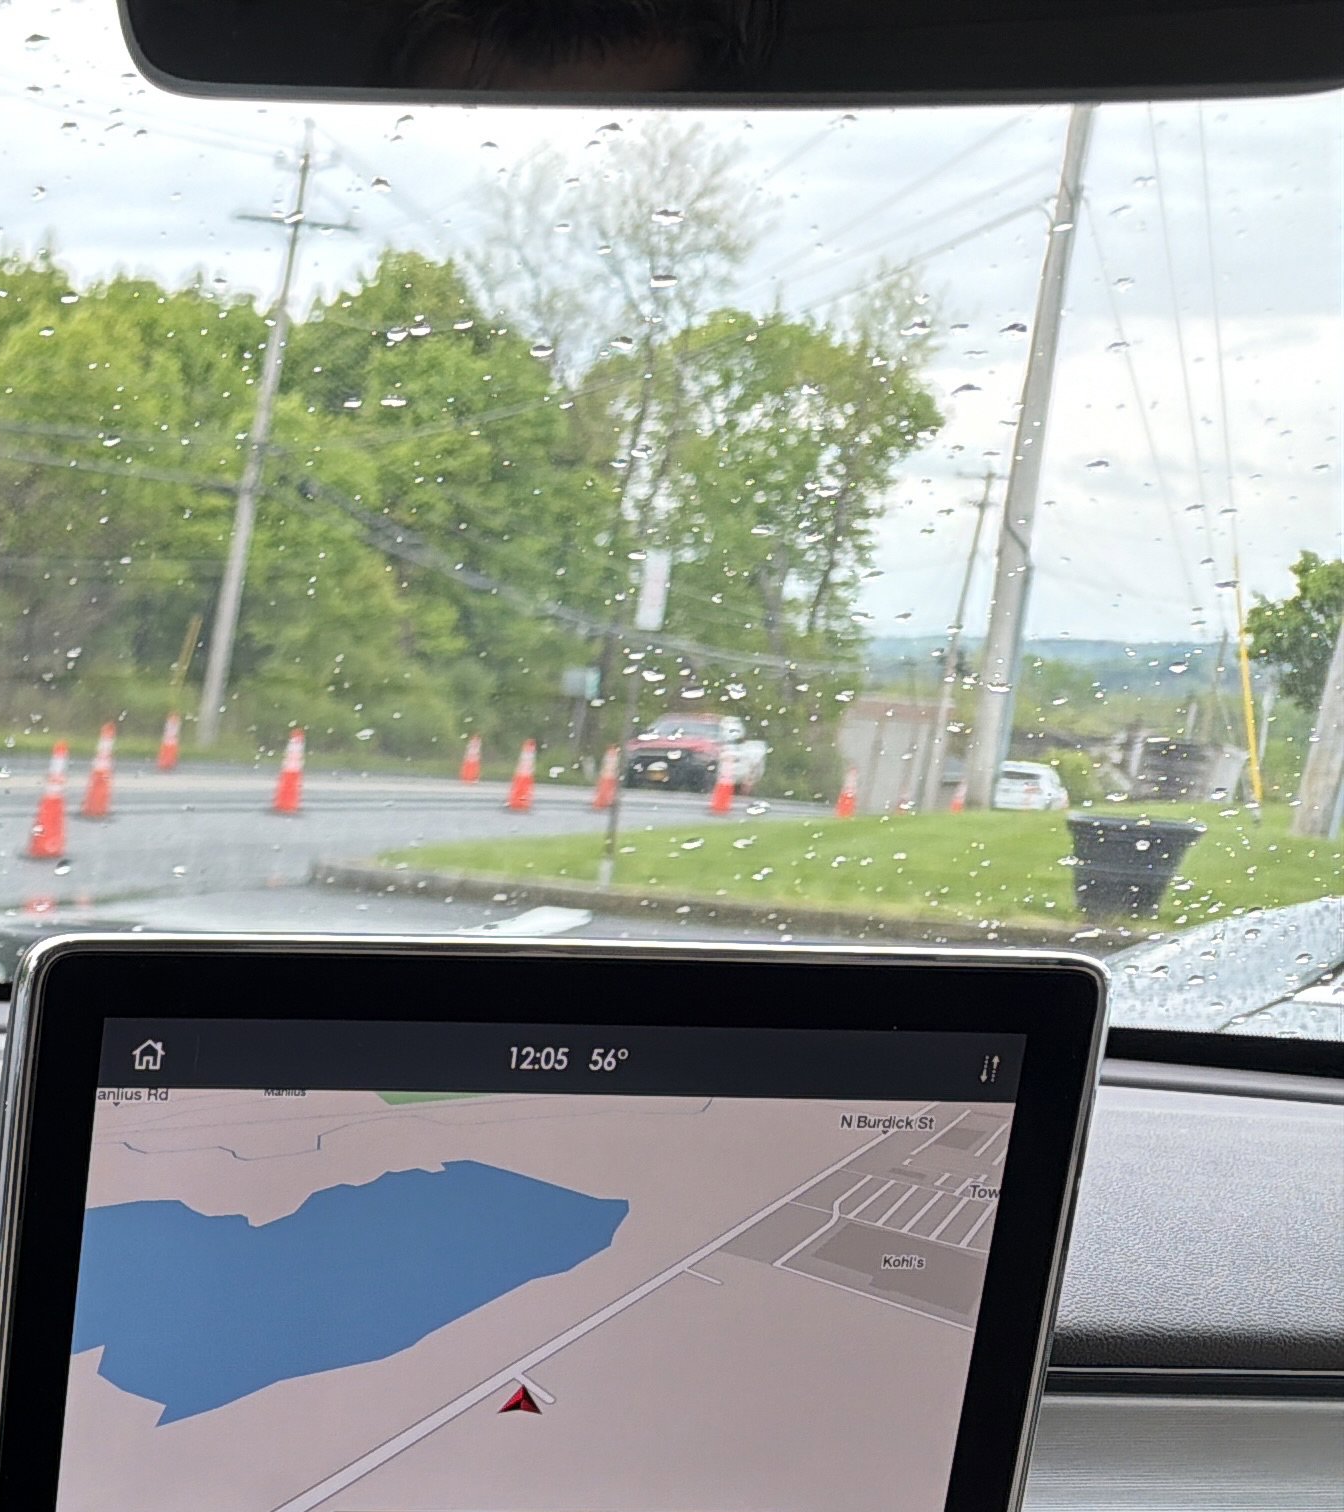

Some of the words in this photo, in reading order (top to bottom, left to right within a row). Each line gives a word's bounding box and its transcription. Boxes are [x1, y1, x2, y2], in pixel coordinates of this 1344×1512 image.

[510, 1046, 570, 1070] 12:05
[588, 1047, 629, 1071] 56°
[146, 1088, 169, 1101] Rd
[840, 1115, 854, 1129] N
[856, 1115, 913, 1131] Burdick
[915, 1116, 935, 1131] St
[882, 1255, 925, 1270] Kohl's
